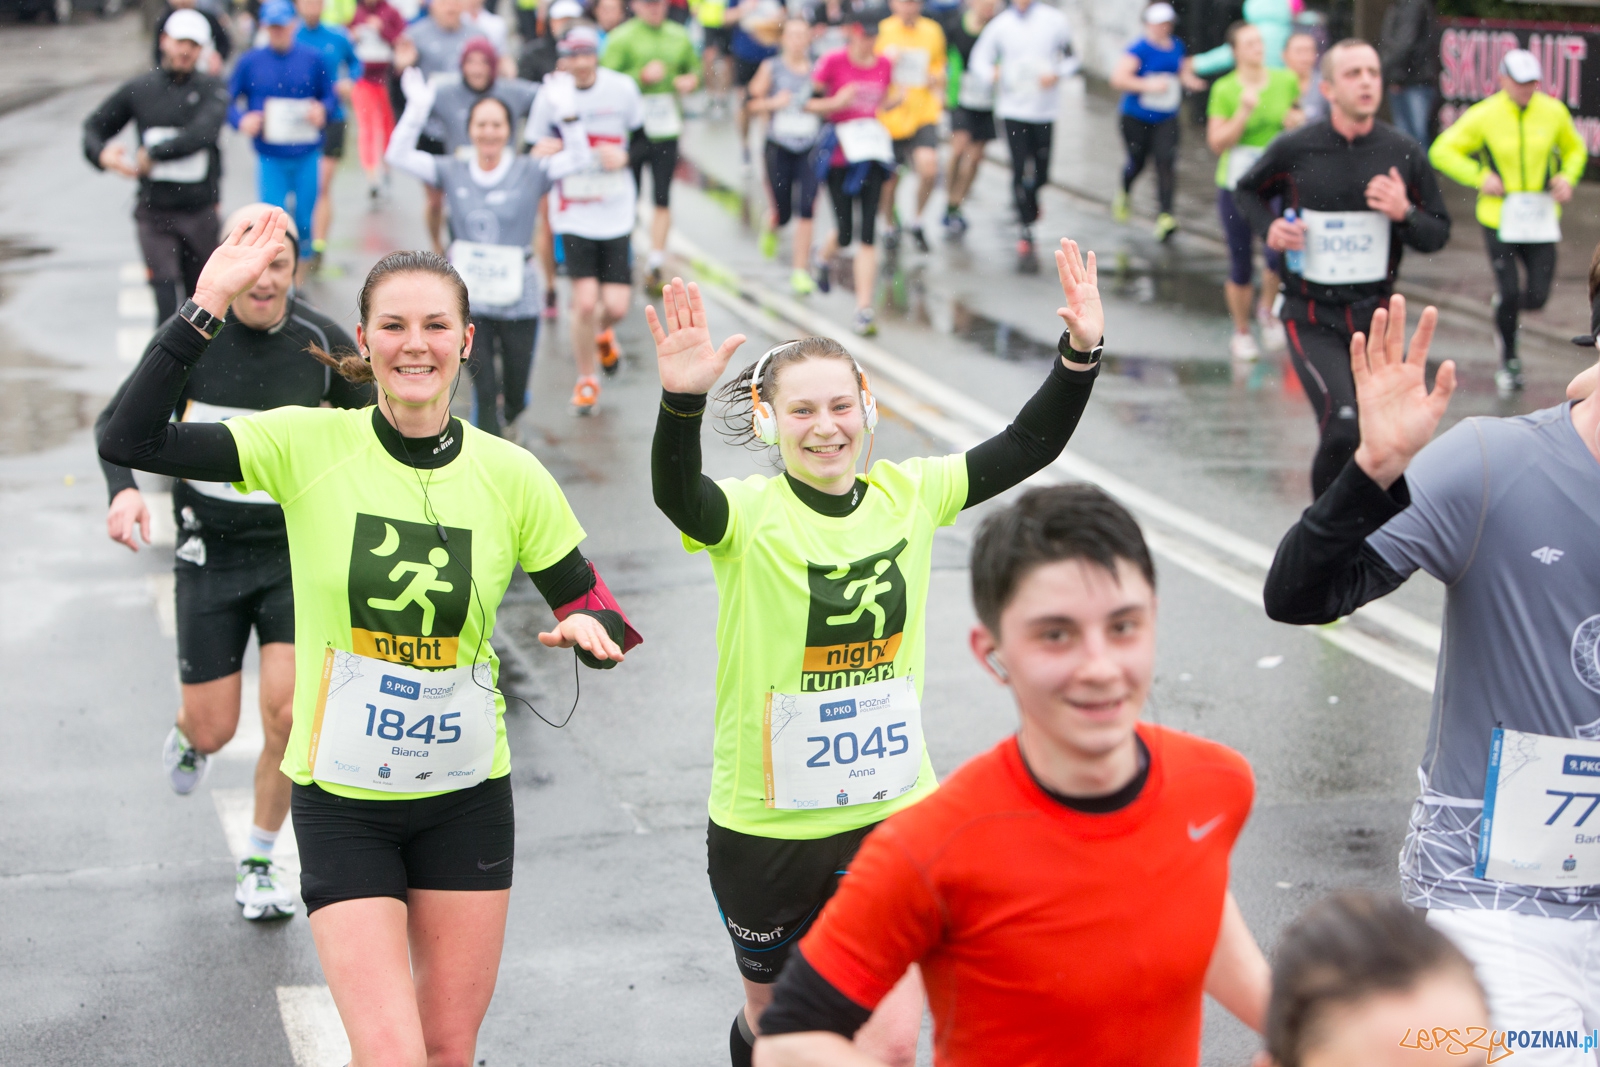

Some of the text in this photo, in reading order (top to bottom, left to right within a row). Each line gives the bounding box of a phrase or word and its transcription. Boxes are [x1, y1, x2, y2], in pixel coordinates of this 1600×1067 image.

[1529, 33, 1587, 109] UT
[1531, 546, 1565, 565] 4F
[374, 635, 441, 662] night
[802, 663, 893, 691] runners
[365, 703, 462, 744] 1845
[391, 746, 429, 757] Bianca
[806, 721, 909, 768] 2045
[848, 767, 876, 779] Anna
[1544, 789, 1600, 827] 77
